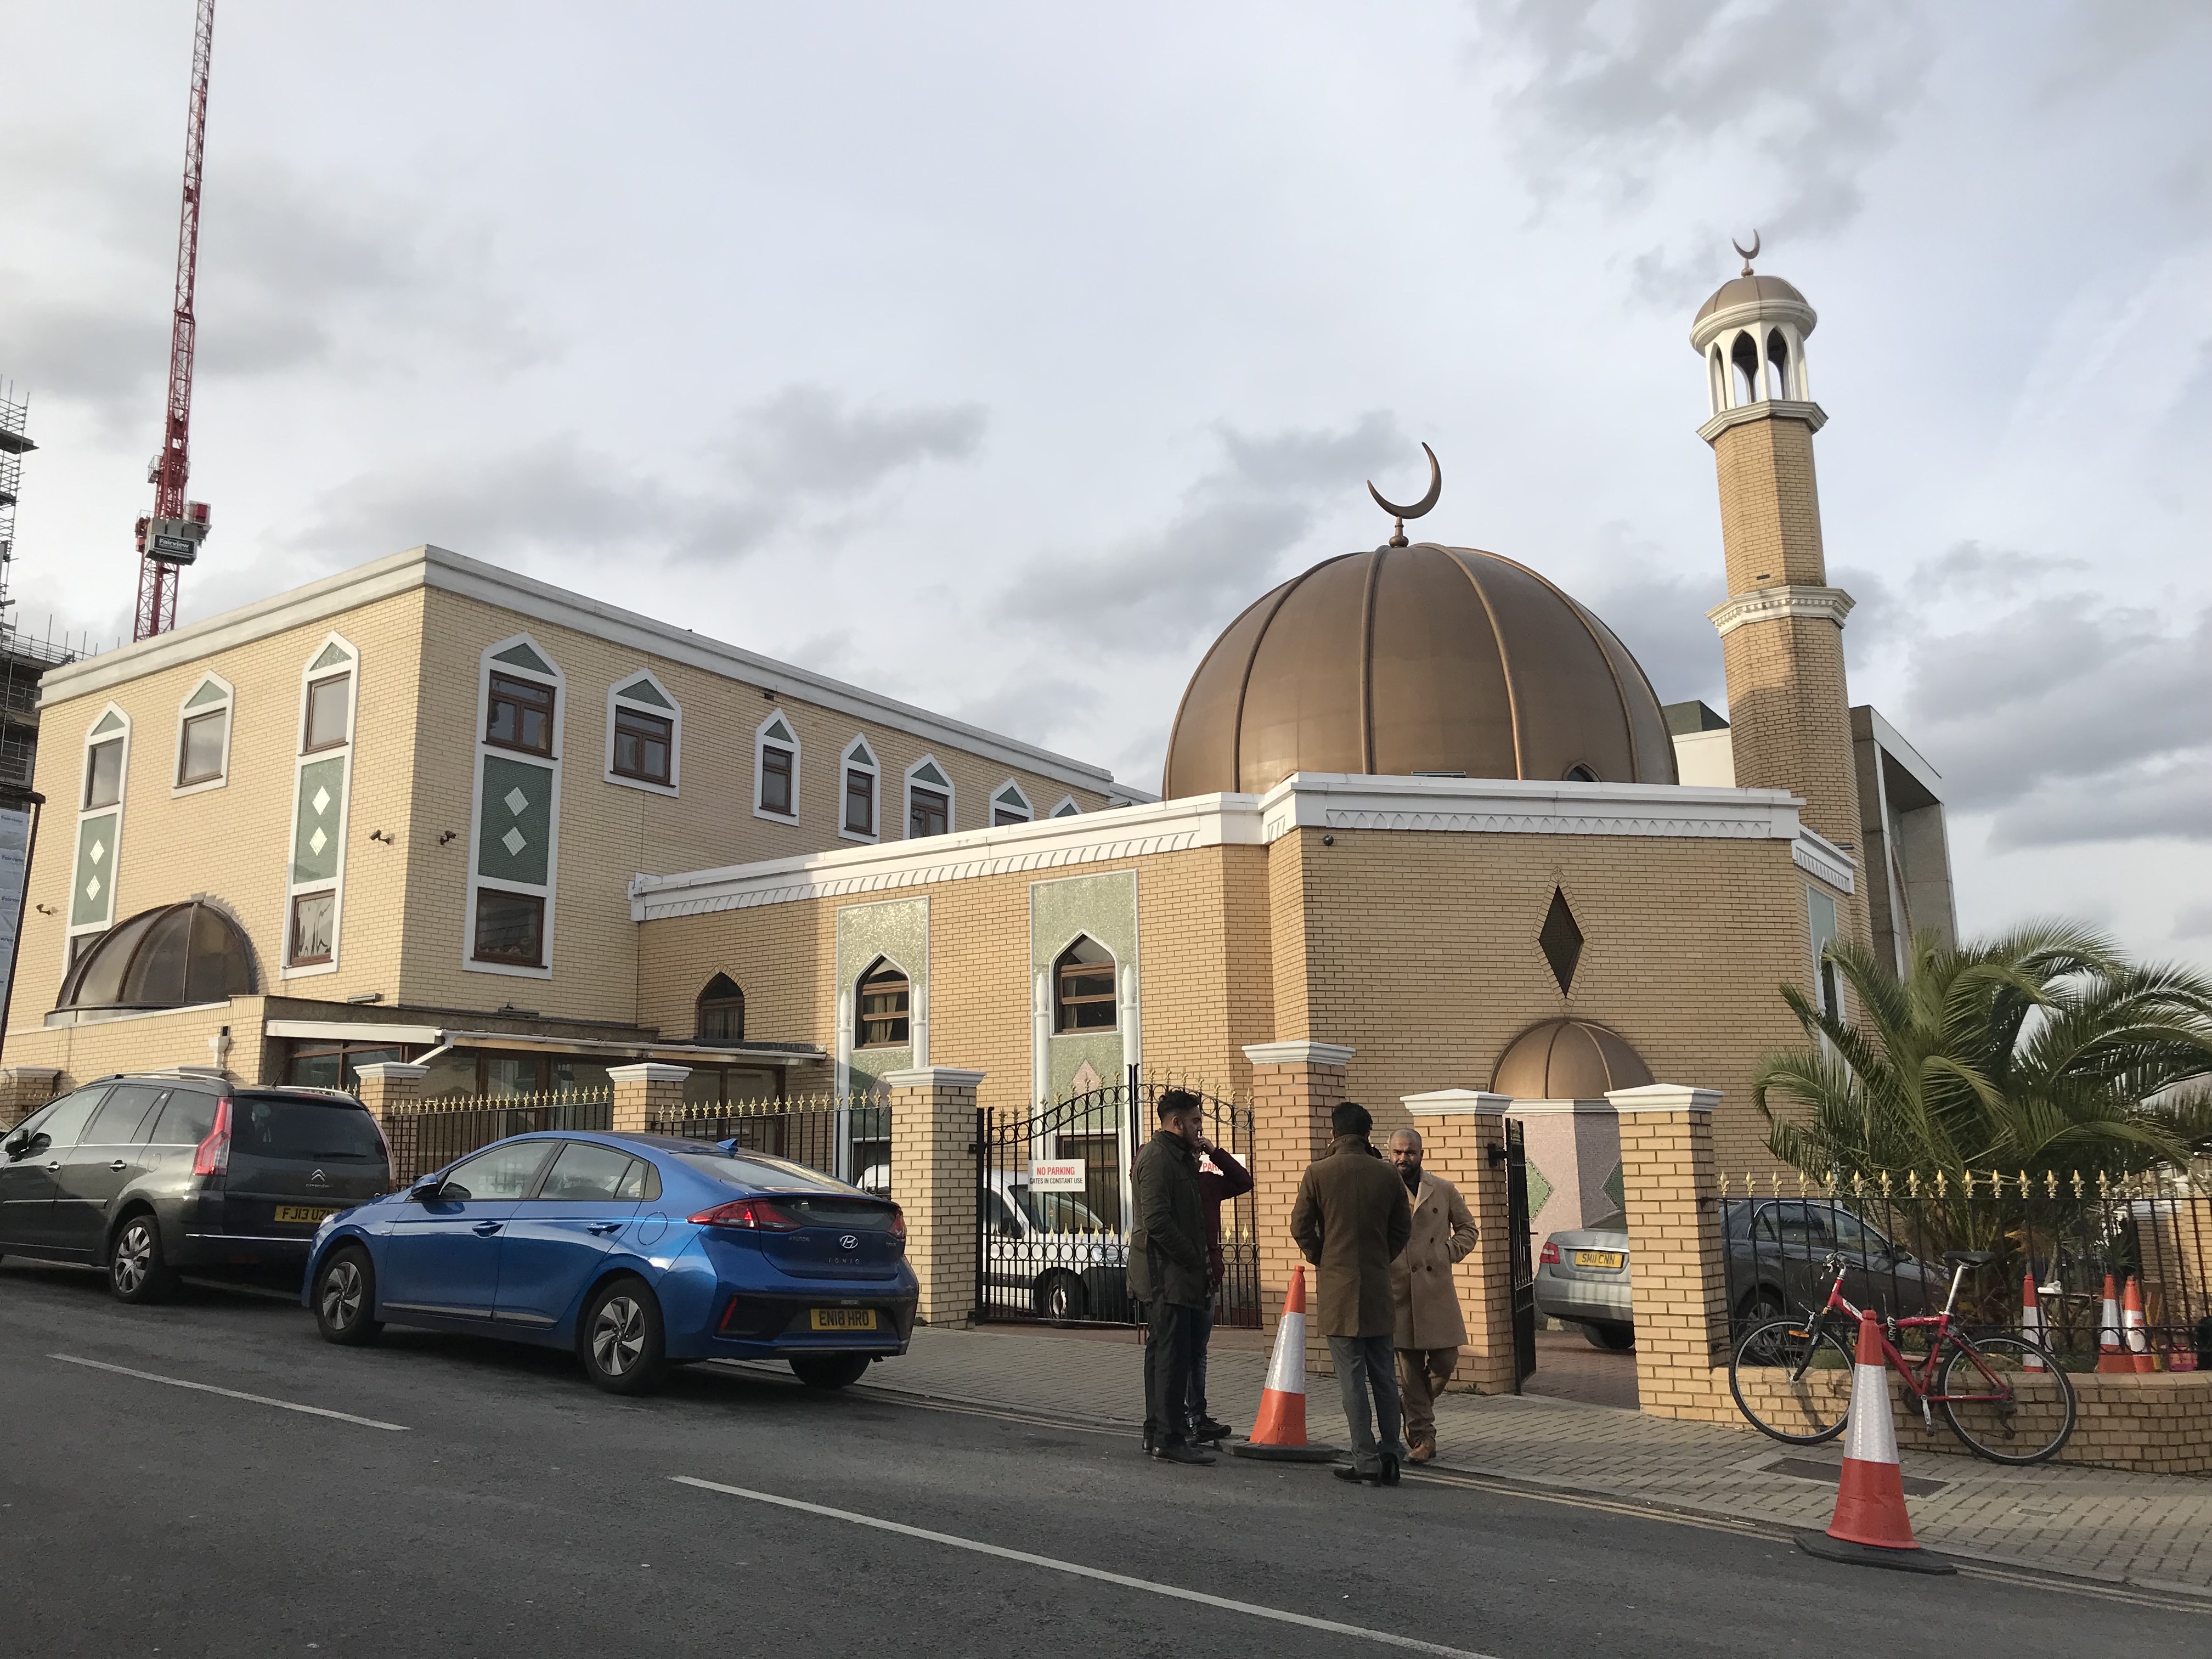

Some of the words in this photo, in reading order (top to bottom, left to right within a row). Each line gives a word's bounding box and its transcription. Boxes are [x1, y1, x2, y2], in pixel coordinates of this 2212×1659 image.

[1036, 1167, 1046, 1175] NO
[1047, 1166, 1075, 1175] PARKING
[282, 1207, 309, 1220] FJ13
[1598, 1255, 1615, 1265] CNN
